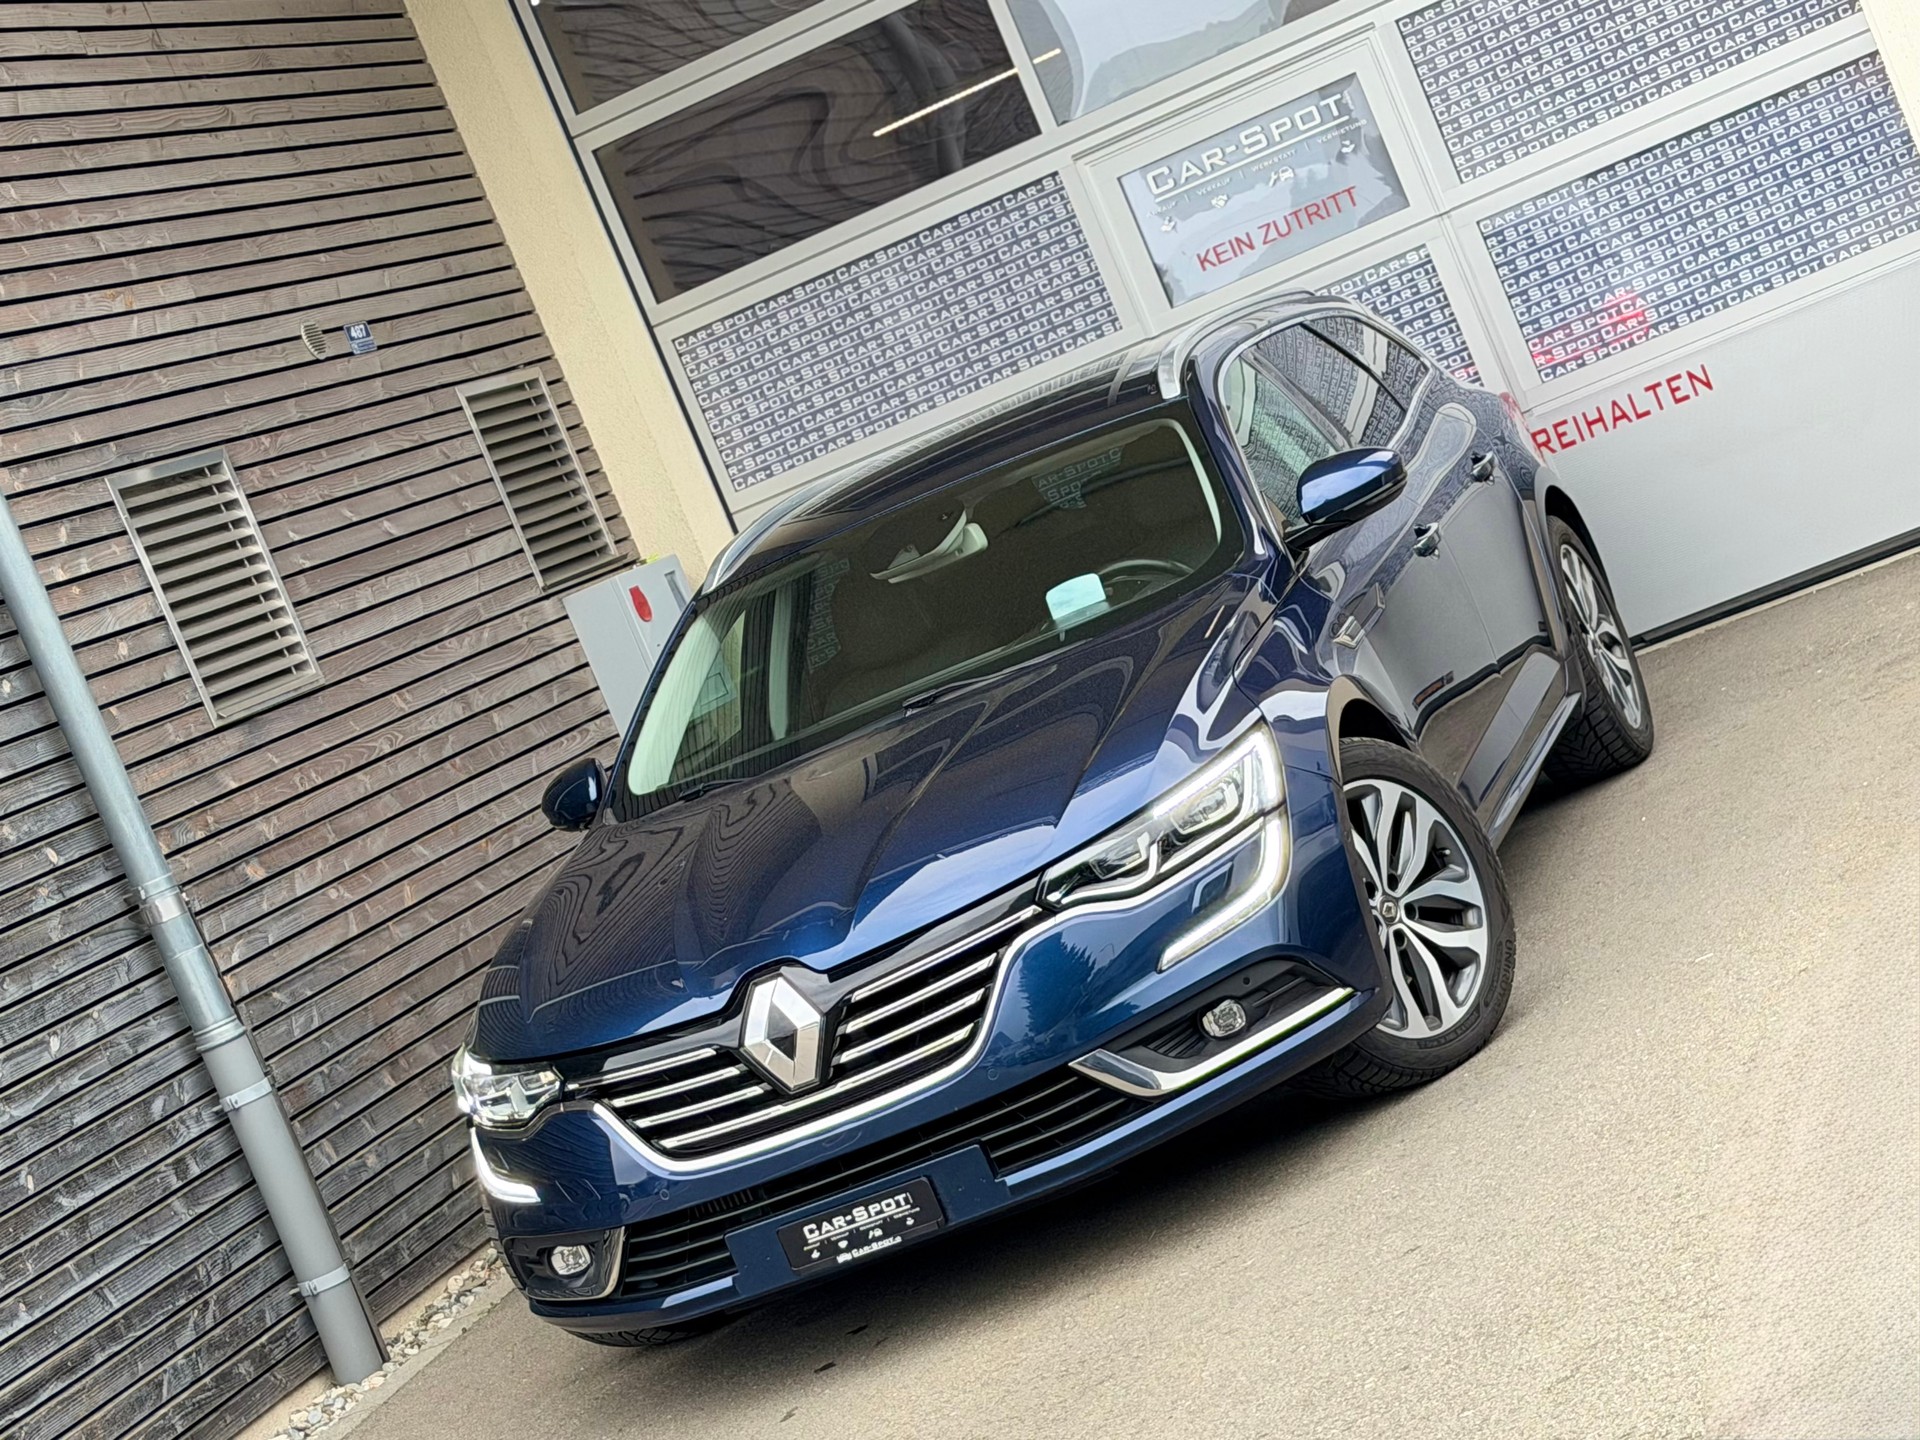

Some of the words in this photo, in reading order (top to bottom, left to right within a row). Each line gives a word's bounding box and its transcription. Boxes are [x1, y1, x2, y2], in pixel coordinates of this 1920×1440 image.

[1410, 13, 1503, 61] CAR-SPOT
[1422, 44, 1515, 92] CAR-SPOT
[1514, 3, 1609, 52] CAR-SPOT
[1434, 73, 1527, 121] CAR-SPOT
[1526, 32, 1621, 81] CAR-SPOT
[1447, 104, 1539, 152] CAR-SPOT
[1538, 63, 1633, 112] CAR-SPOT
[1632, 22, 1729, 71] CAR-SPOT
[1483, 0, 1577, 47] CAR-SPOT
[1495, 29, 1590, 78] CAR-SPOT
[1507, 59, 1602, 107] CAR-SPOT
[1600, 17, 1696, 67] CAR-SPOT
[1520, 90, 1614, 138] CAR-SPOT
[1613, 49, 1709, 98] CAR-SPOT
[1708, 7, 1806, 57] CAR-SPOT
[1147, 94, 1341, 194] CAR-SPOT
[1459, 135, 1552, 182] CAR-SPOT
[1551, 94, 1646, 142] CAR-SPOT
[1644, 53, 1741, 102] CAR-SPOT
[1740, 11, 1837, 61] CAR-SPOT
[1480, 187, 1572, 233] CAR-SPOT
[1571, 147, 1665, 194] CAR-SPOT
[1664, 106, 1761, 154] CAR-SPOT
[1761, 64, 1858, 113] CAR-SPOT
[1552, 173, 1646, 220] CAR-SPOT
[1645, 132, 1741, 180] CAR-SPOT
[1740, 91, 1838, 139] CAR-SPOT
[1196, 232, 1256, 272] KEIN
[1257, 185, 1357, 246] ZUTRITT
[1491, 216, 1584, 262] CAR-SPOT
[1583, 176, 1677, 223] CAR-SPOT
[1676, 136, 1773, 183] CAR-SPOT
[1773, 94, 1870, 142] CAR-SPOT
[1504, 247, 1596, 293] CAR-SPOT
[1595, 207, 1690, 254] CAR-SPOT
[1689, 167, 1785, 215] CAR-SPOT
[1785, 126, 1883, 174] CAR-SPOT
[1515, 276, 1608, 322] CAR-SPOT
[1607, 237, 1701, 283] CAR-SPOT
[1700, 197, 1797, 244] CAR-SPOT
[1797, 156, 1895, 204] CAR-SPOT
[1564, 202, 1658, 249] CAR-SPOT
[1657, 162, 1753, 209] CAR-SPOT
[1752, 121, 1850, 169] CAR-SPOT
[1576, 233, 1671, 280] CAR-SPOT
[1669, 194, 1766, 241] CAR-SPOT
[1765, 152, 1863, 201] CAR-SPOT
[674, 308, 755, 351] CAR-SPOT
[754, 273, 837, 316] CAR-SPOT
[835, 237, 920, 280] CAR-SPOT
[918, 200, 1004, 244] CAR-SPOT
[686, 336, 767, 377] CAR-SPOT
[766, 300, 848, 342] CAR-SPOT
[847, 265, 931, 307] CAR-SPOT
[930, 228, 1015, 271] CAR-SPOT
[738, 297, 821, 339] CAR-SPOT
[819, 261, 903, 304] CAR-SPOT
[902, 225, 987, 268] CAR-SPOT
[1527, 307, 1620, 352] CAR-SPOT
[1619, 268, 1714, 314] CAR-SPOT
[1713, 228, 1810, 275] CAR-SPOT
[1810, 187, 1908, 235] CAR-SPOT
[1588, 263, 1683, 309] CAR-SPOT
[1681, 223, 1778, 270] CAR-SPOT
[1777, 182, 1875, 231] CAR-SPOT
[1600, 294, 1695, 340] CAR-SPOT
[1694, 255, 1790, 302] CAR-SPOT
[1790, 214, 1888, 262] CAR-SPOT
[698, 365, 779, 406] CAR-SPOT
[778, 330, 861, 372] CAR-SPOT
[859, 294, 943, 337] CAR-SPOT
[942, 258, 1027, 301] CAR-SPOT
[709, 392, 790, 433] CAR-SPOT
[790, 357, 872, 399] CAR-SPOT
[871, 321, 955, 364] CAR-SPOT
[954, 285, 1039, 328] CAR-SPOT
[750, 325, 832, 366] CAR-SPOT
[831, 289, 914, 331] CAR-SPOT
[914, 253, 998, 295] CAR-SPOT
[762, 354, 845, 395] CAR-SPOT
[843, 318, 927, 360] CAR-SPOT
[926, 282, 1011, 325] CAR-SPOT
[773, 381, 856, 422] CAR-SPOT
[855, 346, 938, 388] CAR-SPOT
[937, 310, 1022, 353] CAR-SPOT
[1540, 338, 1633, 383] CAR-SPOT
[1632, 299, 1727, 345] CAR-SPOT
[1725, 259, 1823, 306] CAR-SPOT
[721, 421, 803, 462] CAR-SPOT
[802, 386, 885, 428] CAR-SPOT
[883, 351, 967, 393] CAR-SPOT
[966, 315, 1051, 358] CAR-SPOT
[734, 450, 815, 491] CAR-SPOT
[814, 415, 897, 457] CAR-SPOT
[895, 381, 979, 422] CAR-SPOT
[978, 345, 1064, 387] CAR-SPOT
[786, 410, 868, 451] CAR-SPOT
[867, 375, 951, 417] CAR-SPOT
[950, 340, 1035, 382] CAR-SPOT
[803, 1193, 907, 1240] CAR-SPOT
